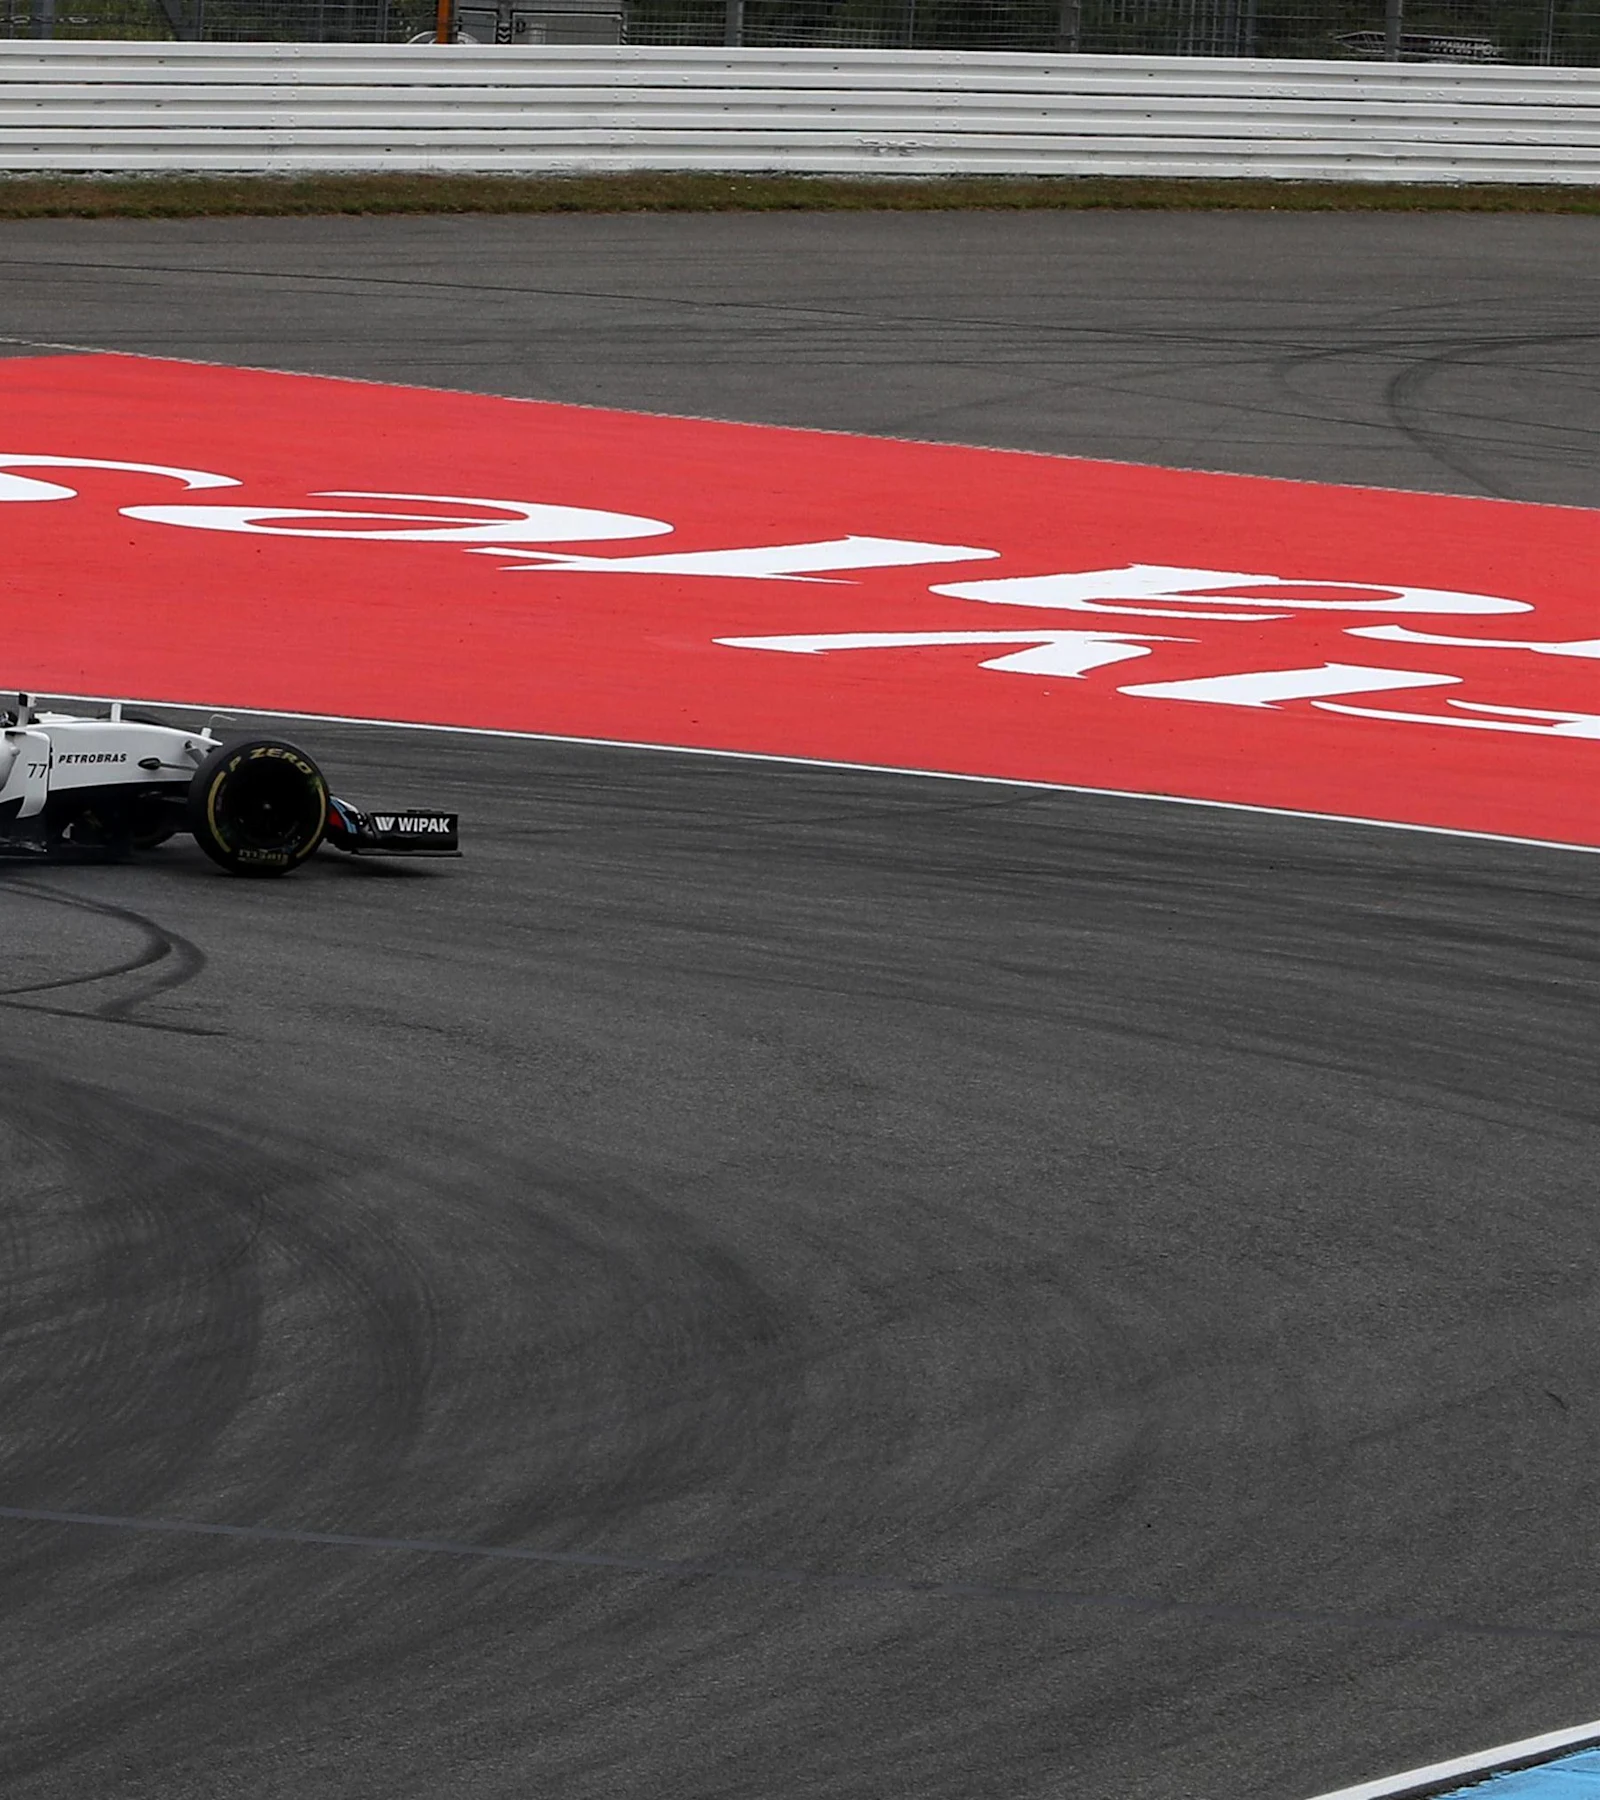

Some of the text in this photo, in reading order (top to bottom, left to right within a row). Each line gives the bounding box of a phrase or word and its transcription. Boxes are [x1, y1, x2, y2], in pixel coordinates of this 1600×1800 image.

[58, 753, 127, 764] PETROBRAS
[228, 747, 313, 774] P ZERO
[27, 763, 48, 779] 77
[398, 817, 450, 833] WIPAK
